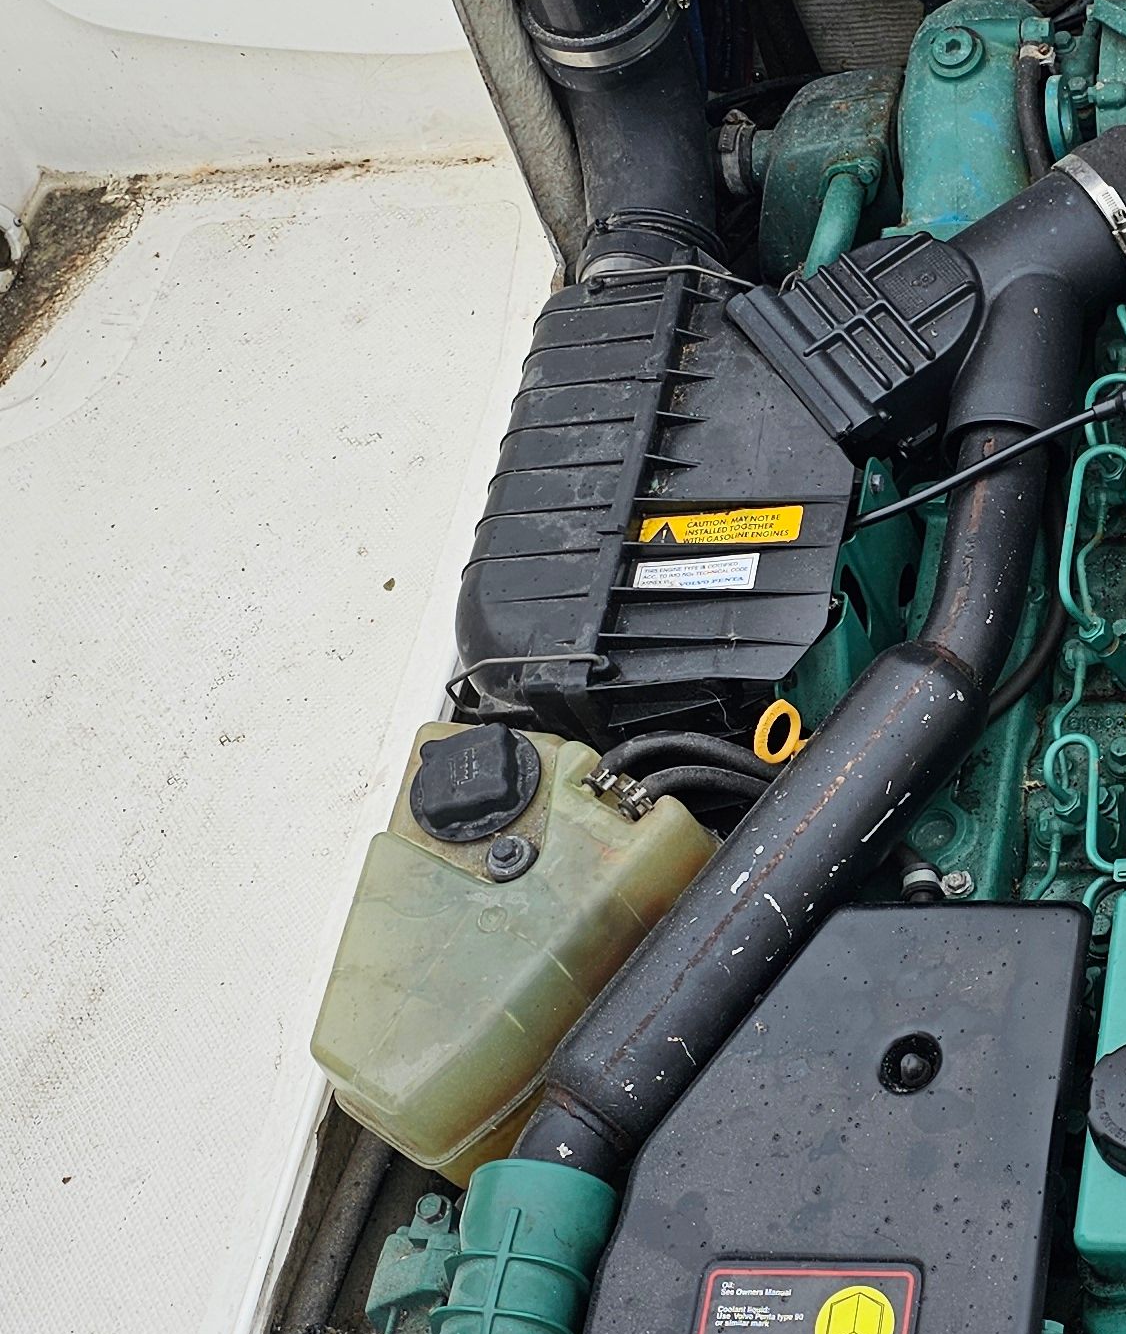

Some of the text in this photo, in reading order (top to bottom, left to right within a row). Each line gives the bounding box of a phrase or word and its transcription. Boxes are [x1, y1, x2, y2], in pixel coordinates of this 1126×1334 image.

[731, 515, 749, 523] MAY
[750, 514, 770, 522] NOT
[684, 522, 775, 536] INSTALLED TOGETHER
[706, 531, 748, 543] GASOLINE
[751, 529, 789, 538] ENGINES
[711, 576, 744, 584] PENTA
[720, 1288, 792, 1296] See Owners Manual
[716, 1312, 731, 1320] Use
[755, 1313, 776, 1321] Penta
[777, 1313, 794, 1322] type
[750, 1320, 770, 1328] mark
